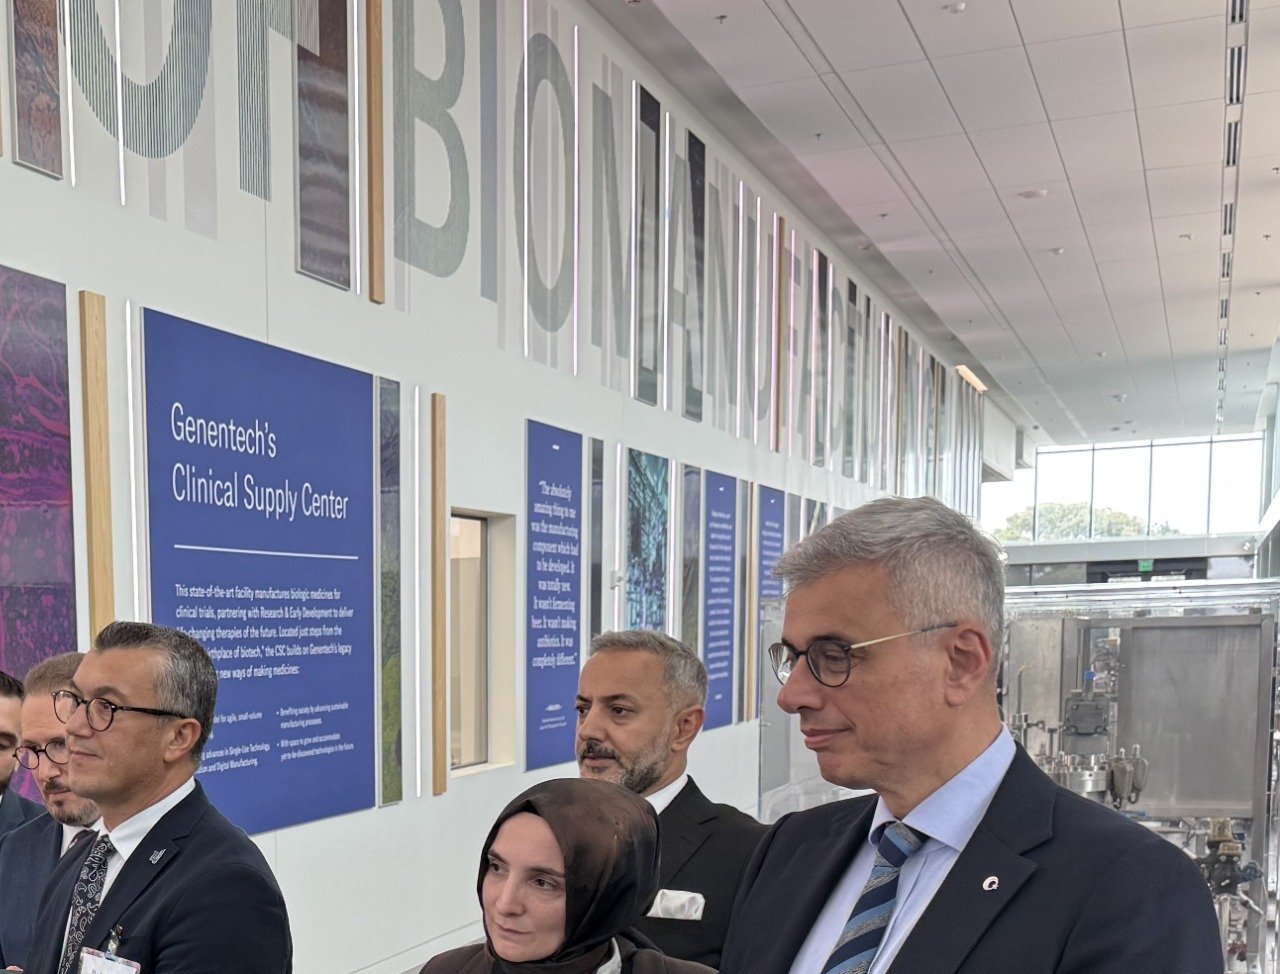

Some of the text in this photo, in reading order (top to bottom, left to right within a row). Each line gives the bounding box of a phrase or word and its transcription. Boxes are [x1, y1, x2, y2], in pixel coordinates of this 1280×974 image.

[172, 463, 348, 521] Clinical Supply Center
[548, 522, 578, 540] manufacturing
[532, 542, 557, 554] component
[175, 584, 188, 597] This
[189, 586, 234, 599] state-of-the-art
[235, 586, 254, 601] facility
[255, 587, 290, 599] manufactures
[291, 587, 309, 602] biologic
[310, 588, 333, 599] medicines
[552, 596, 575, 613] fermenting
[176, 606, 354, 621] clinical trials, partnering with Research & Early Development to deliver
[216, 626, 242, 640] therapies
[243, 626, 249, 637] of
[249, 626, 259, 637] the
[260, 625, 278, 637] future.
[278, 626, 298, 637] Located
[298, 626, 309, 639] just
[309, 626, 322, 638] steps
[322, 625, 333, 636] from
[334, 625, 342, 636] the
[207, 647, 233, 660] irthplace
[234, 646, 240, 658] of
[265, 645, 274, 656] the
[275, 644, 286, 656] CSC
[287, 644, 302, 656] builds
[302, 646, 309, 655] on
[338, 643, 352, 656] legacy
[532, 653, 555, 669] completely
[220, 669, 232, 679] new
[233, 669, 246, 680] ways
[247, 666, 253, 677] of
[254, 666, 272, 678] making
